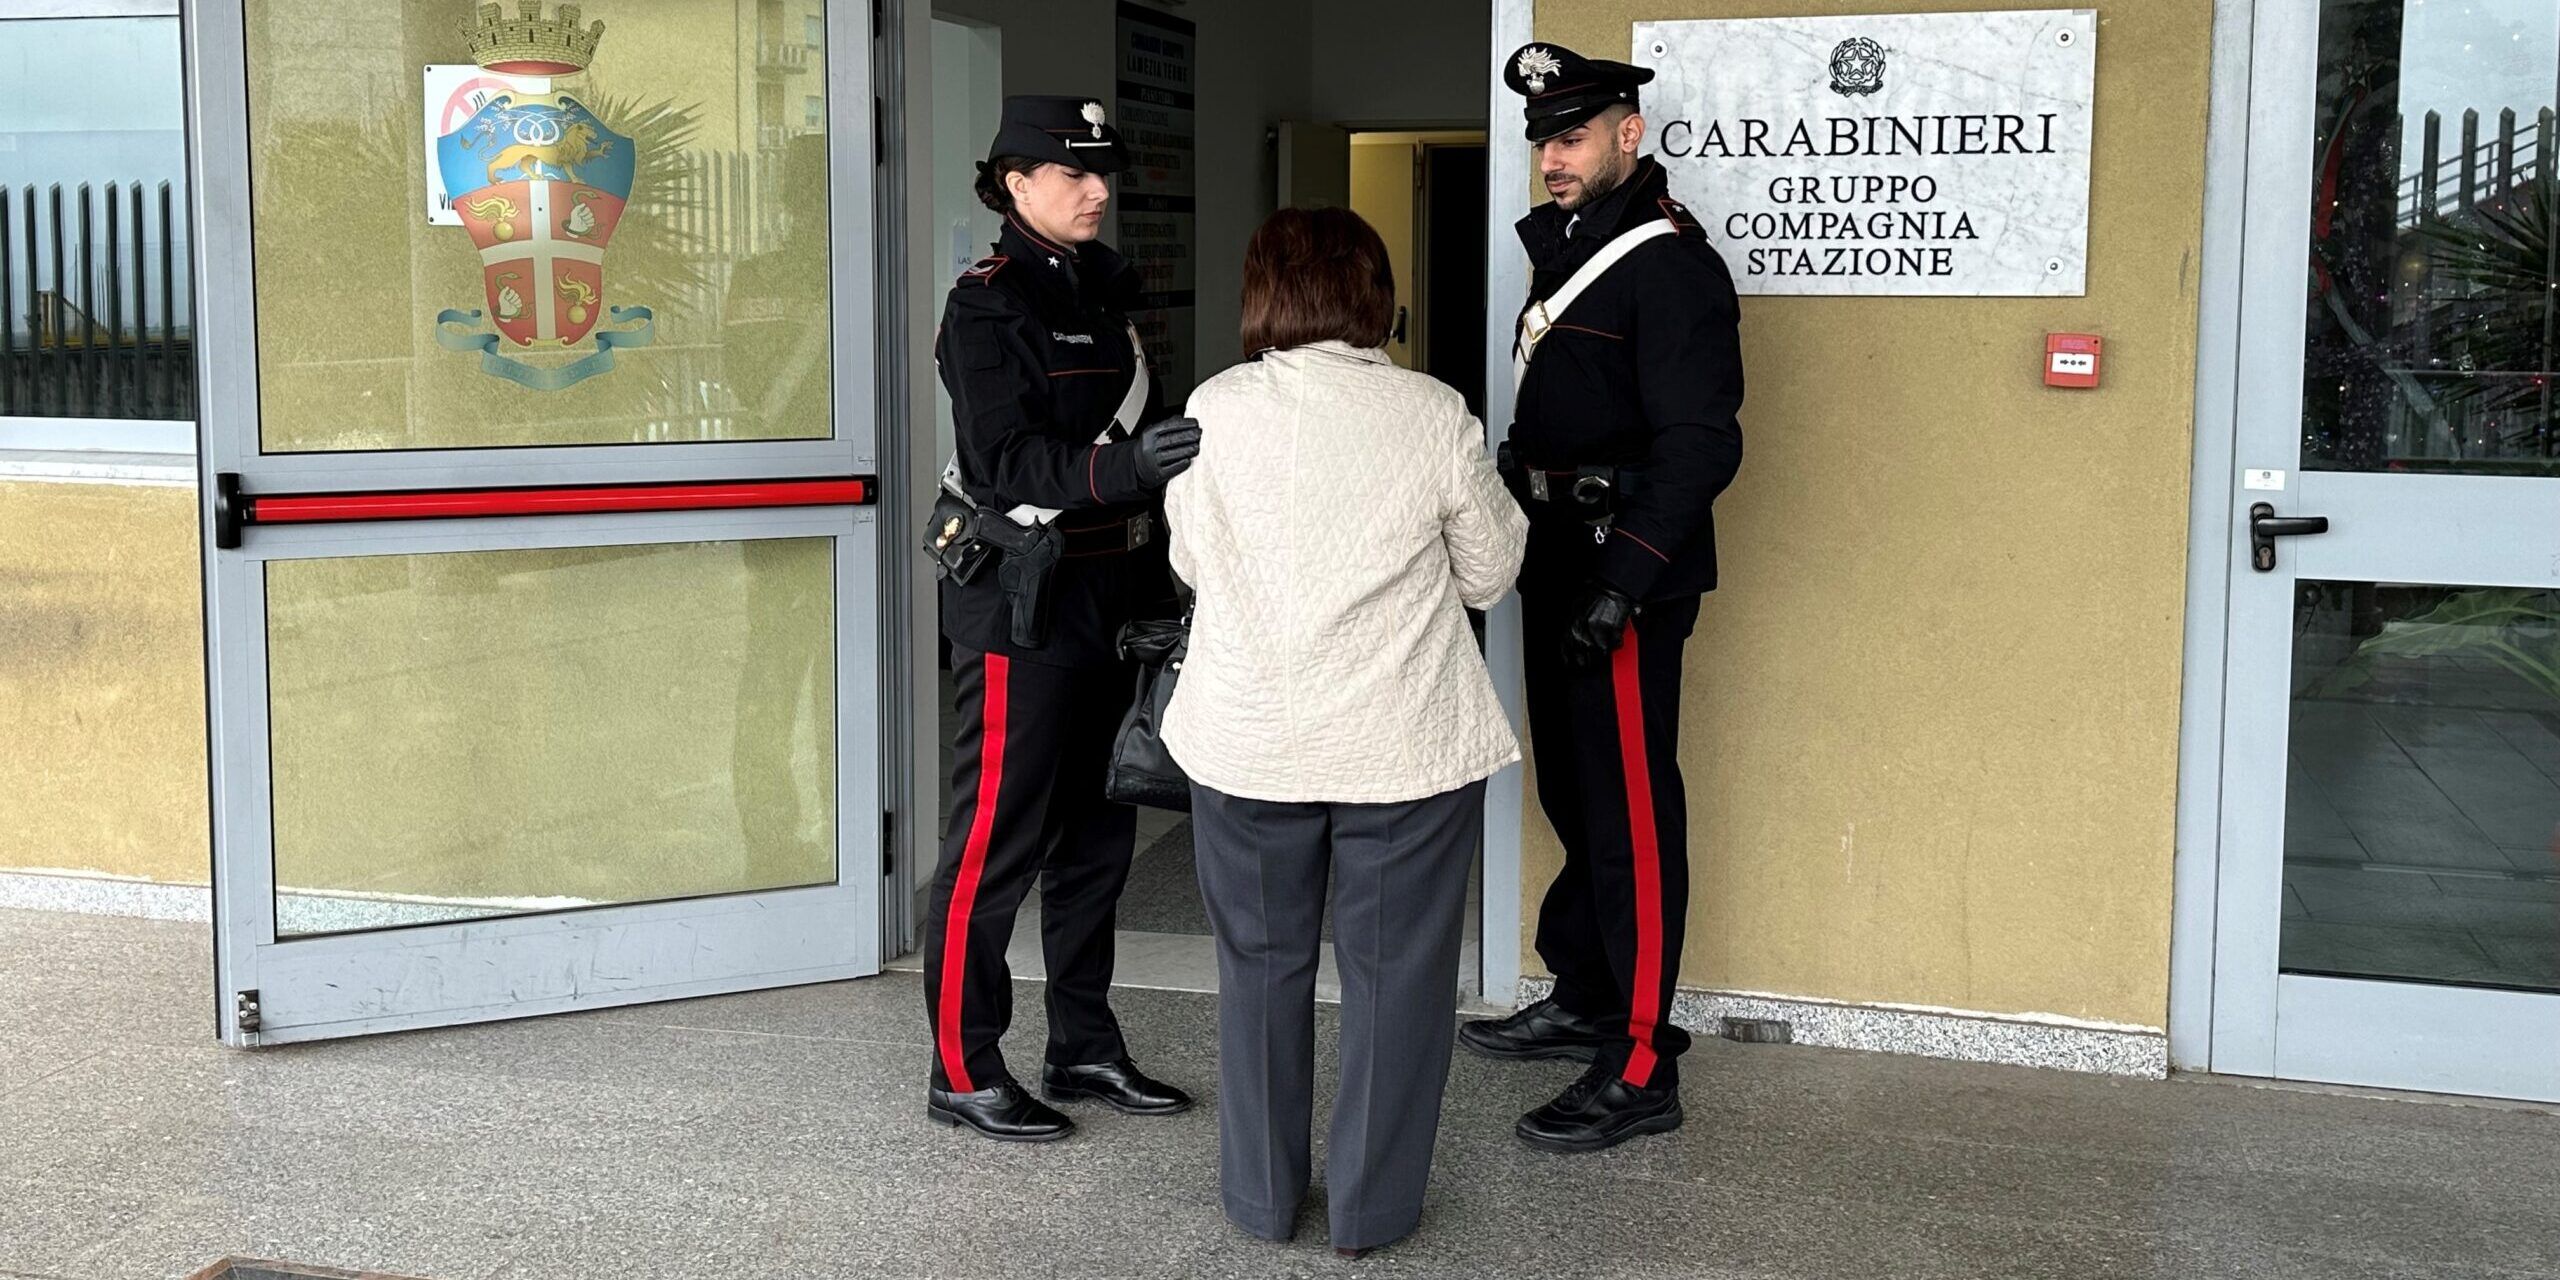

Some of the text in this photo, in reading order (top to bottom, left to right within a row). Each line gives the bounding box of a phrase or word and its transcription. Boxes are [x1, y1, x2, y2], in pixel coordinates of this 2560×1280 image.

[1660, 113, 2057, 158] CARABINIERI
[1768, 175, 1937, 204] GRUPPO
[1725, 211, 1980, 240] COMPAGNIA
[1747, 247, 1953, 277] STAZIONE
